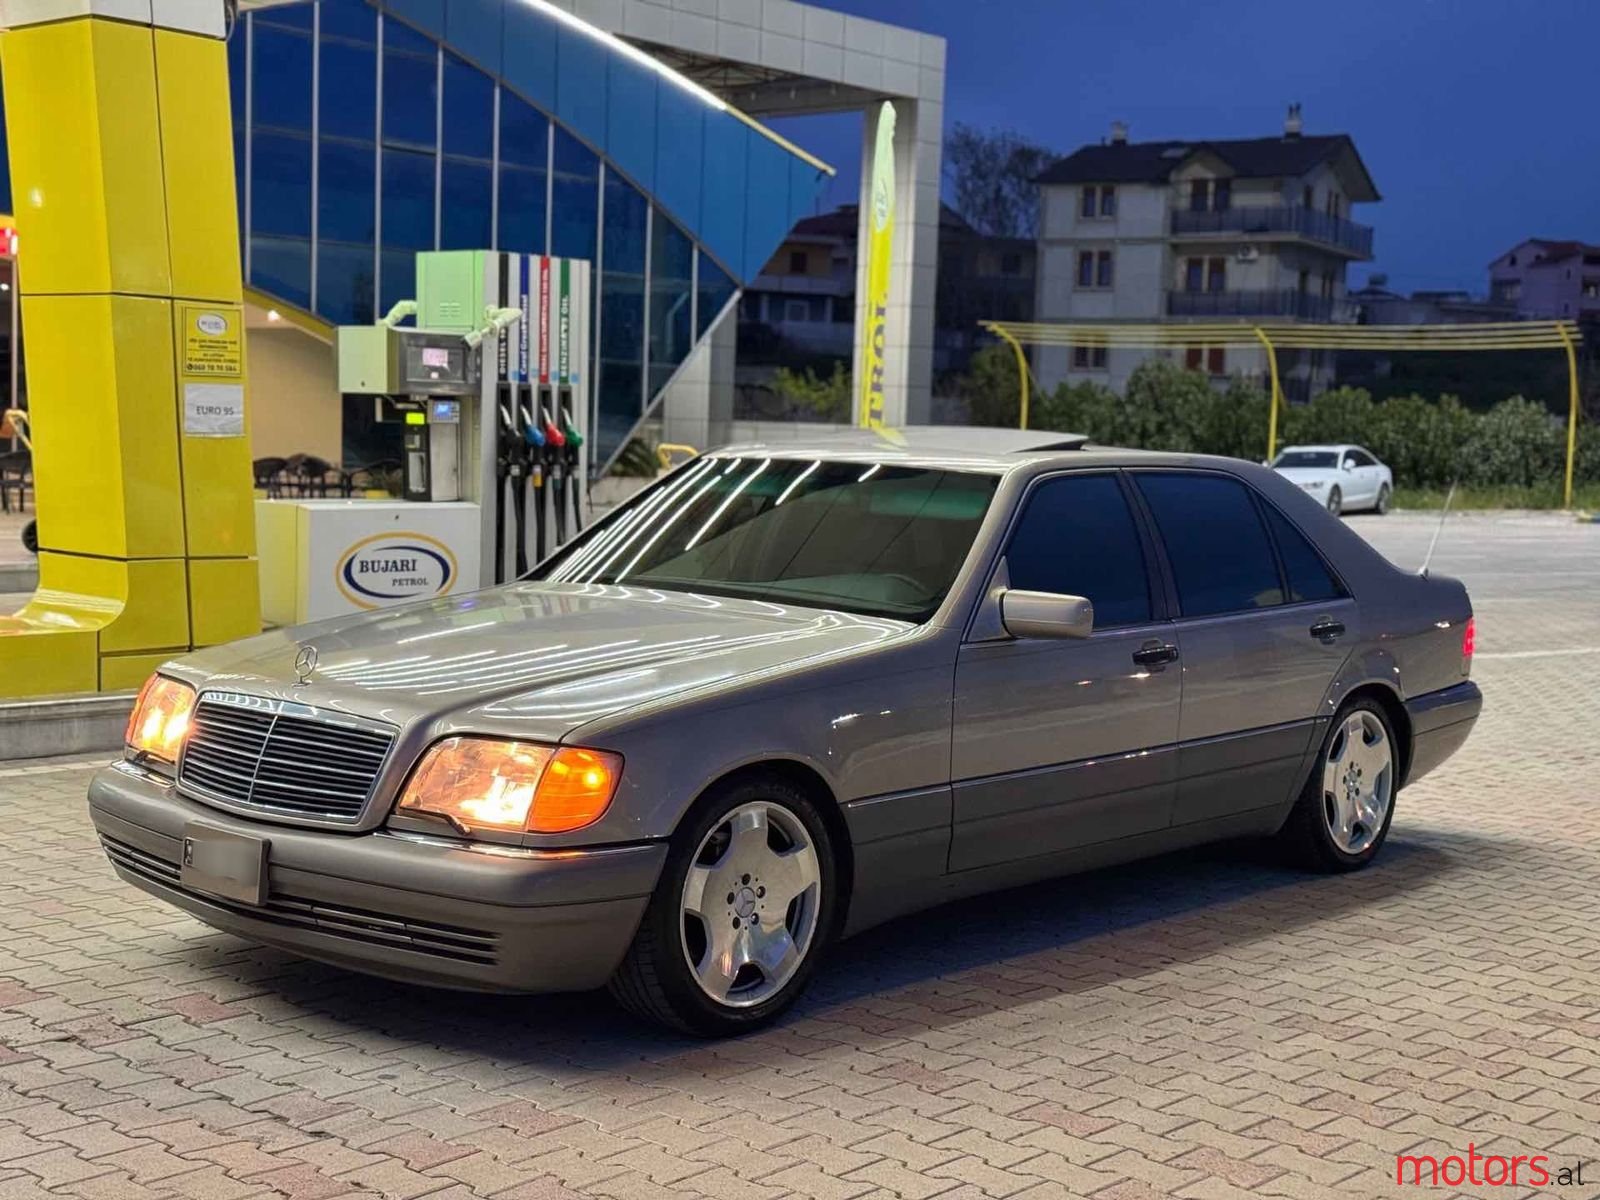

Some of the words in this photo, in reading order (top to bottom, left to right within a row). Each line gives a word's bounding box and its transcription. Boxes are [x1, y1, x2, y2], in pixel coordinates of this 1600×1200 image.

[499, 341, 507, 374] DIESEL
[196, 405, 221, 415] EURO
[223, 406, 234, 416] 95
[359, 559, 417, 573] BUJARI
[392, 578, 428, 587] PETROL
